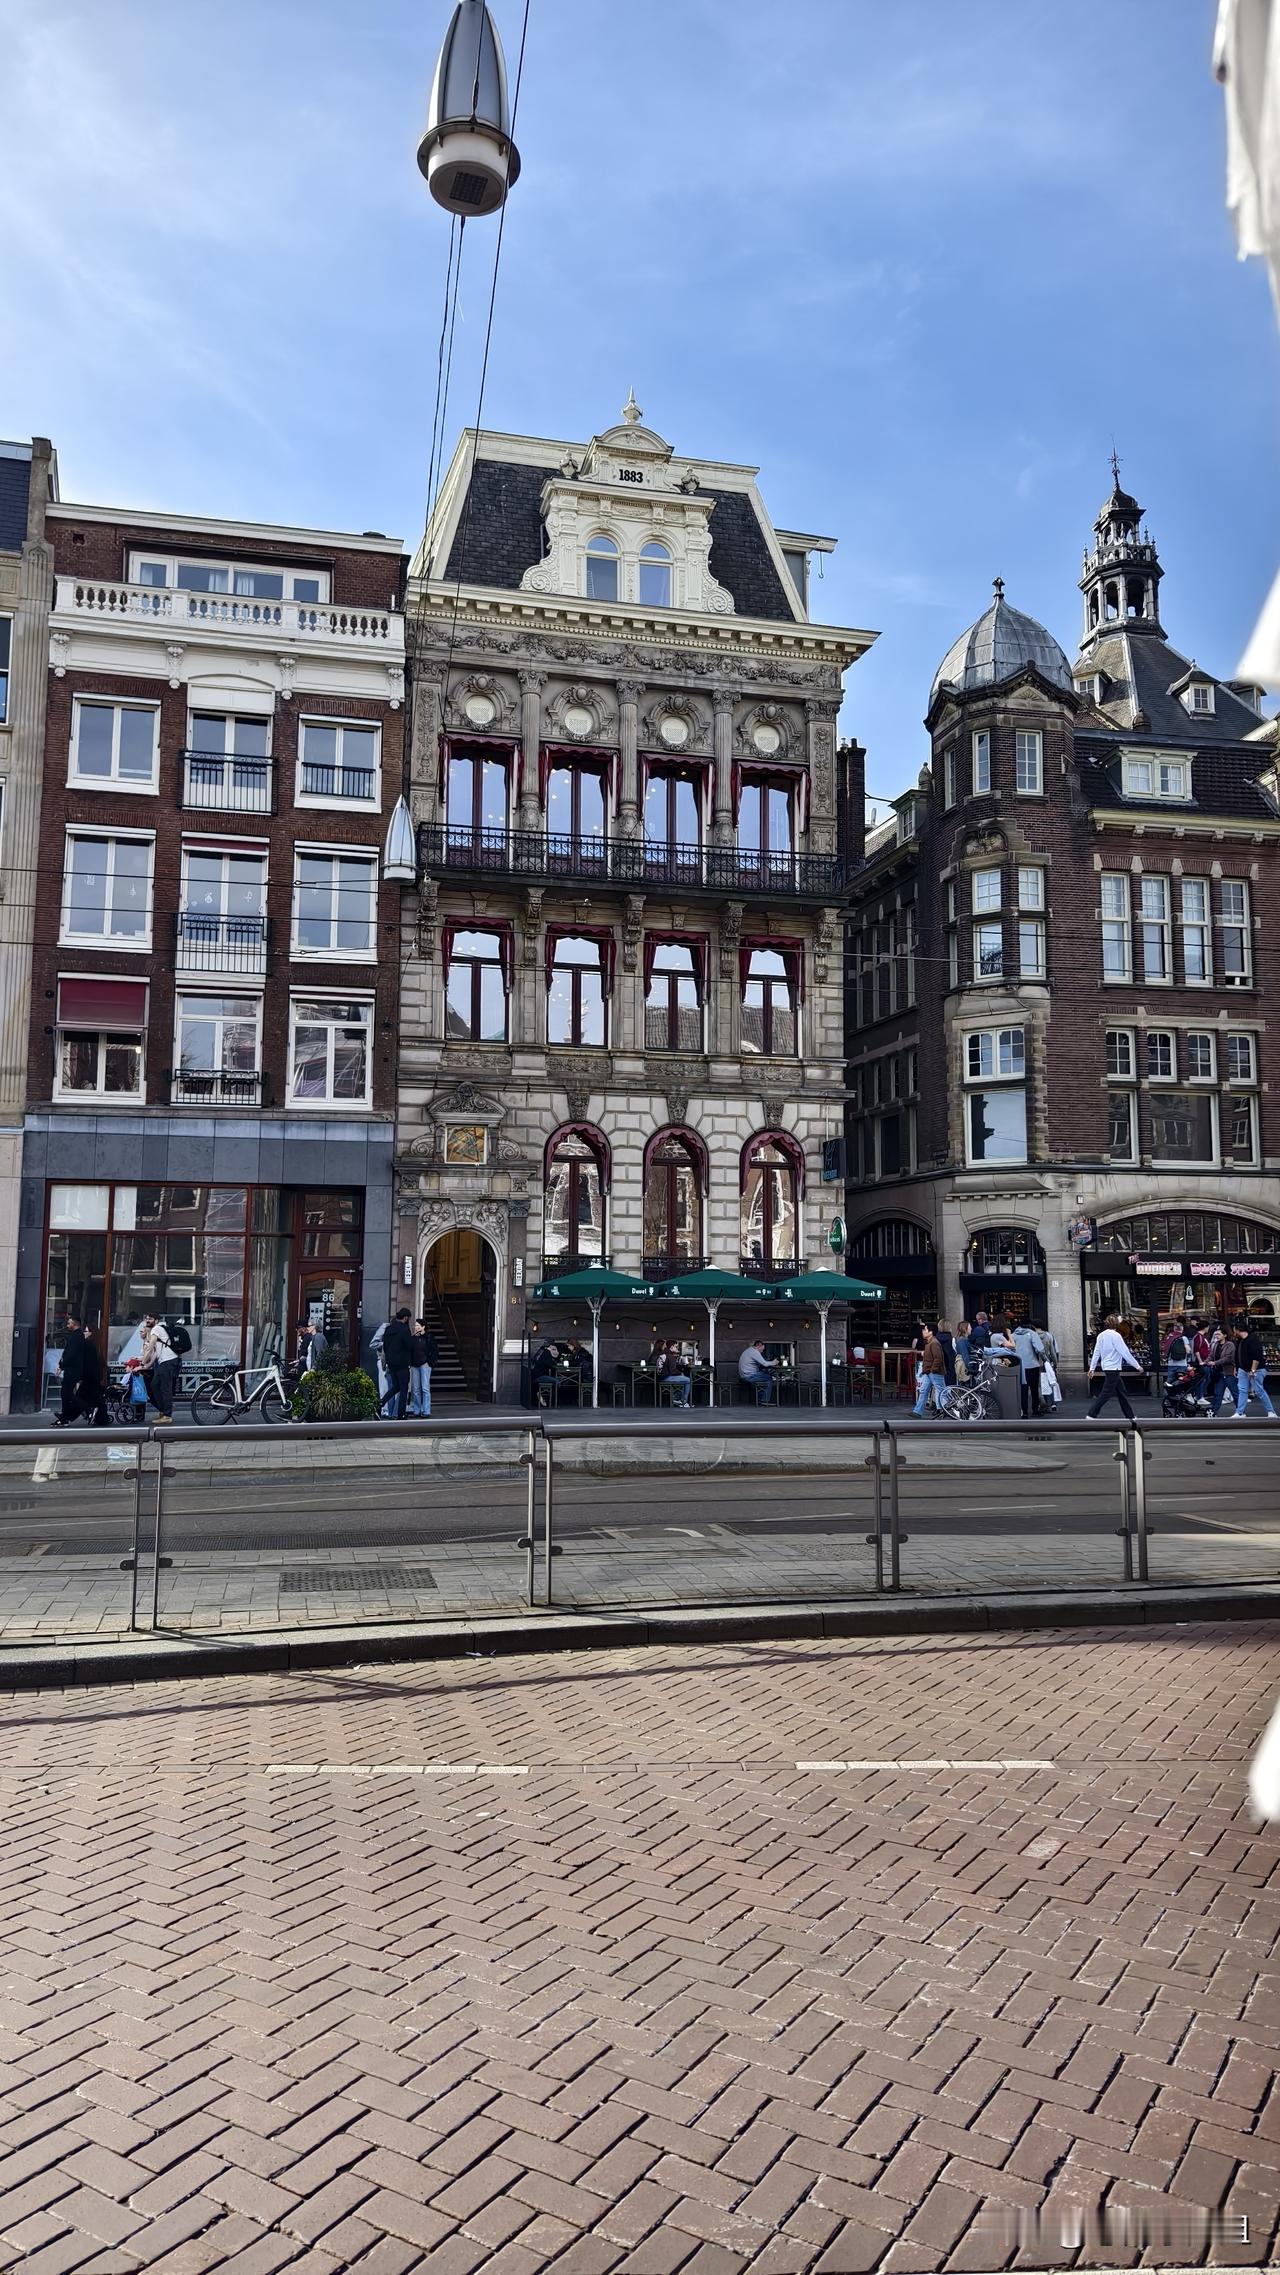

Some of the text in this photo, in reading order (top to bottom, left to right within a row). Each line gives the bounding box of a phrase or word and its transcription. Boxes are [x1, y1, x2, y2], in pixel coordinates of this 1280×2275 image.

[618, 468, 644, 483] 1883
[404, 1255, 413, 1285] WEEKDAY
[515, 1257, 523, 1287] WEEKDAY
[1190, 1262, 1226, 1276] DUCK
[1230, 1263, 1270, 1276] STORE
[322, 1293, 335, 1302] 86
